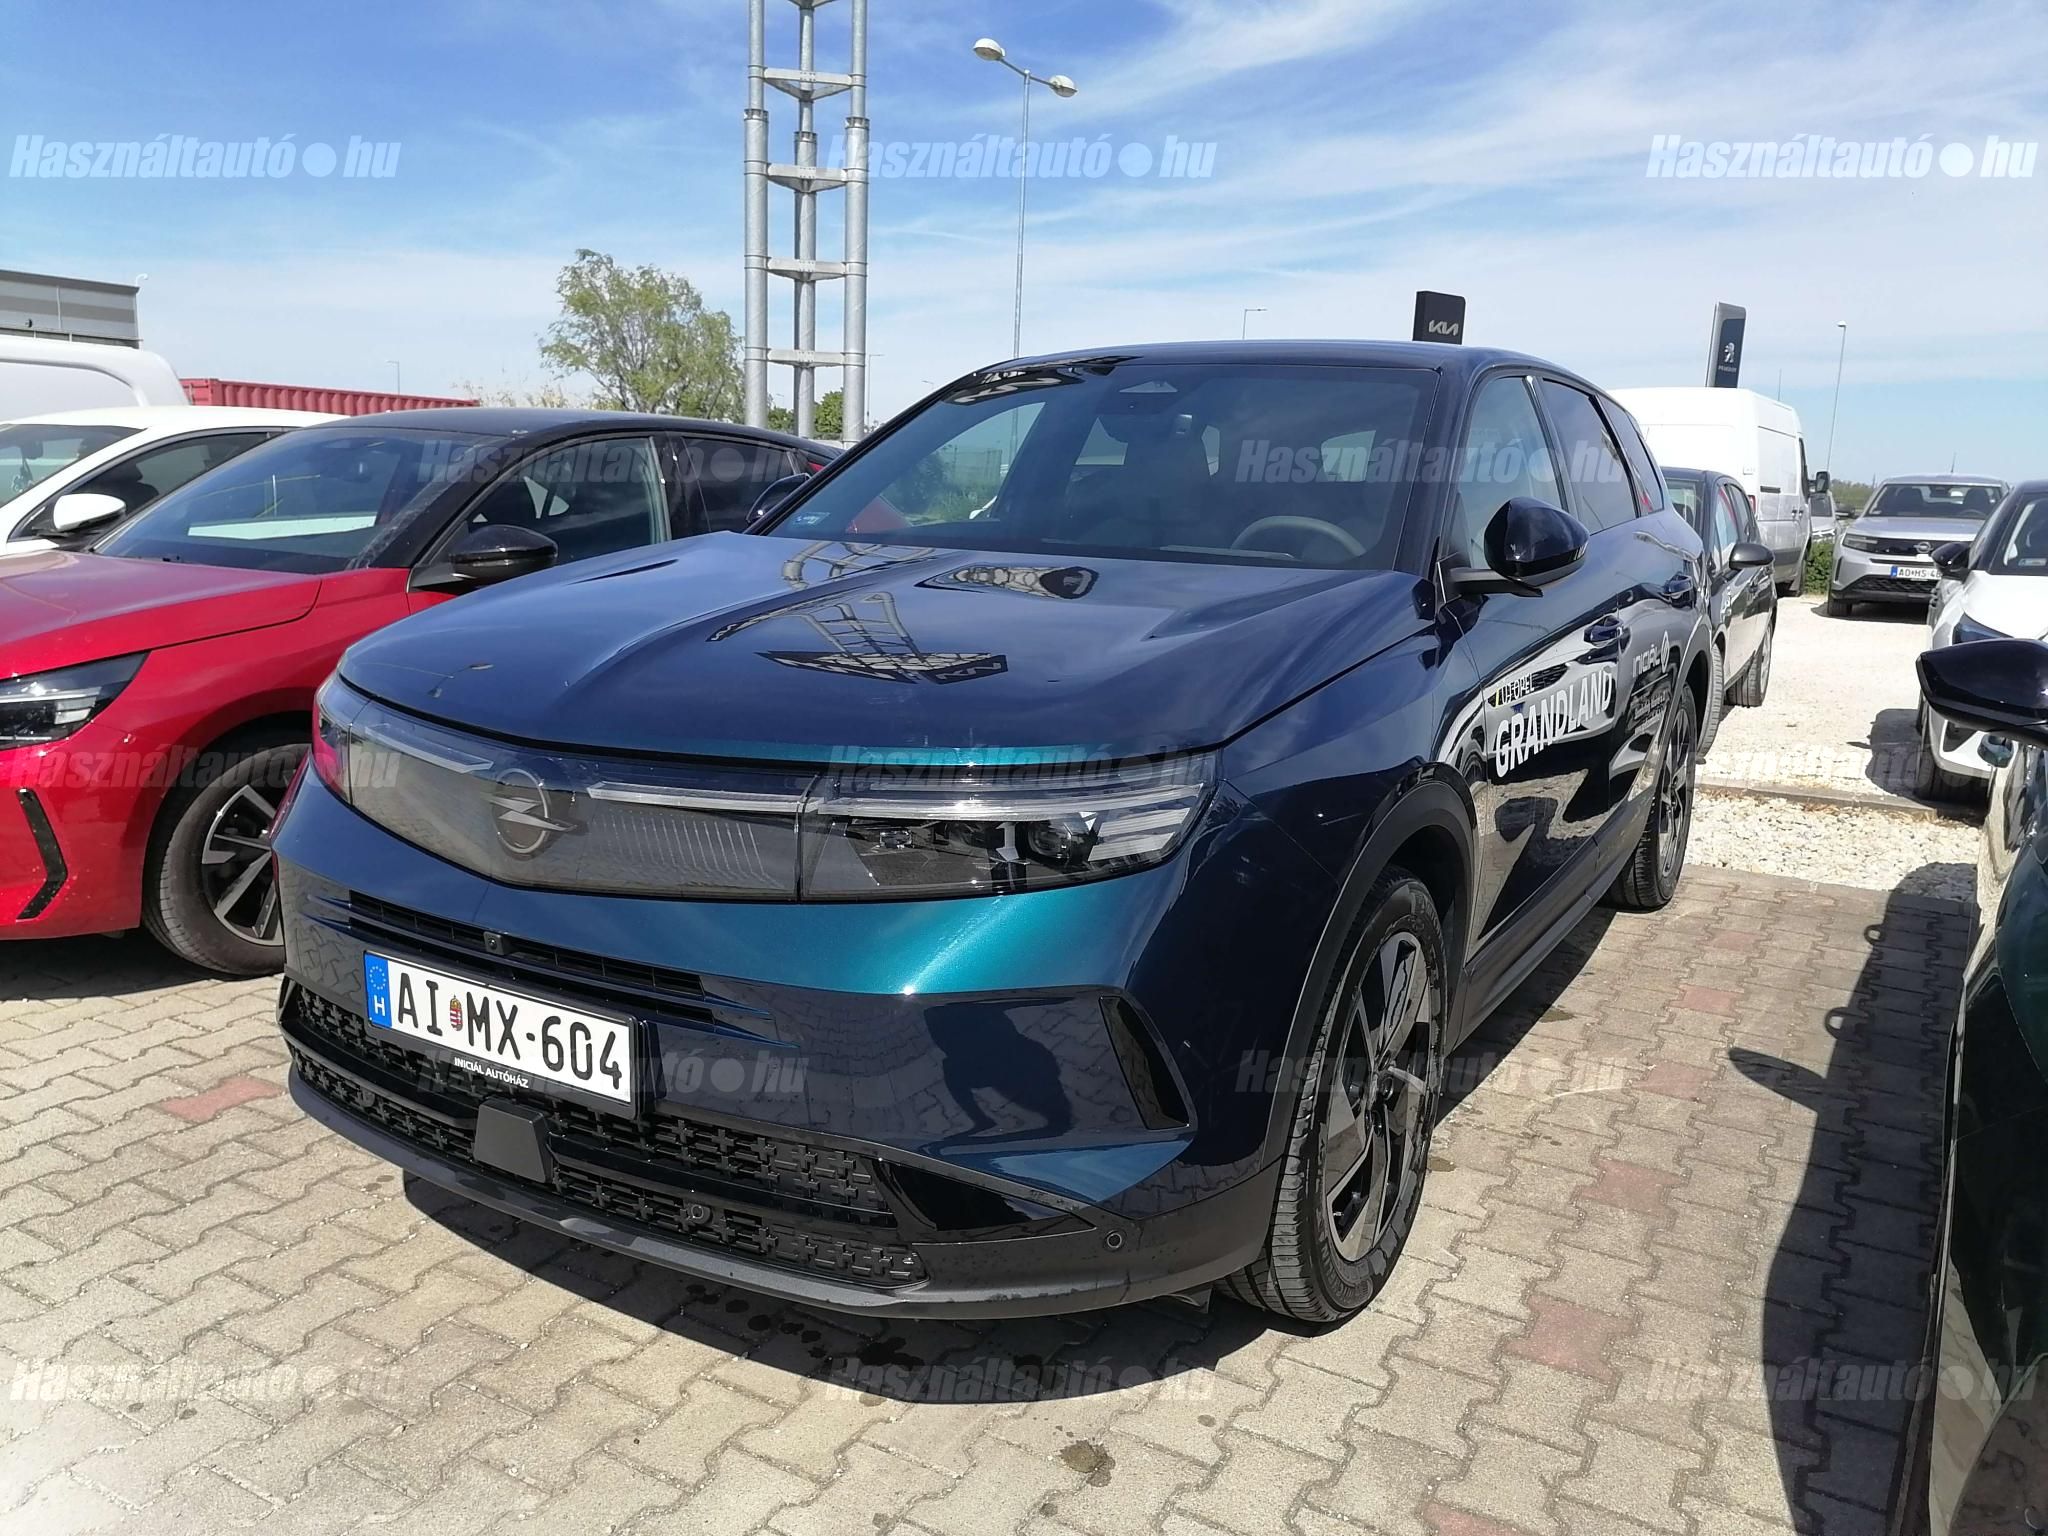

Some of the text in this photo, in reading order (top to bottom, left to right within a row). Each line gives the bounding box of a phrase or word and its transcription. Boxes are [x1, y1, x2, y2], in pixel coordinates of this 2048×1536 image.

[1495, 668, 1613, 777] GRANDLAND
[454, 1056, 529, 1089] INICIÁL AUTÓHÁZ
